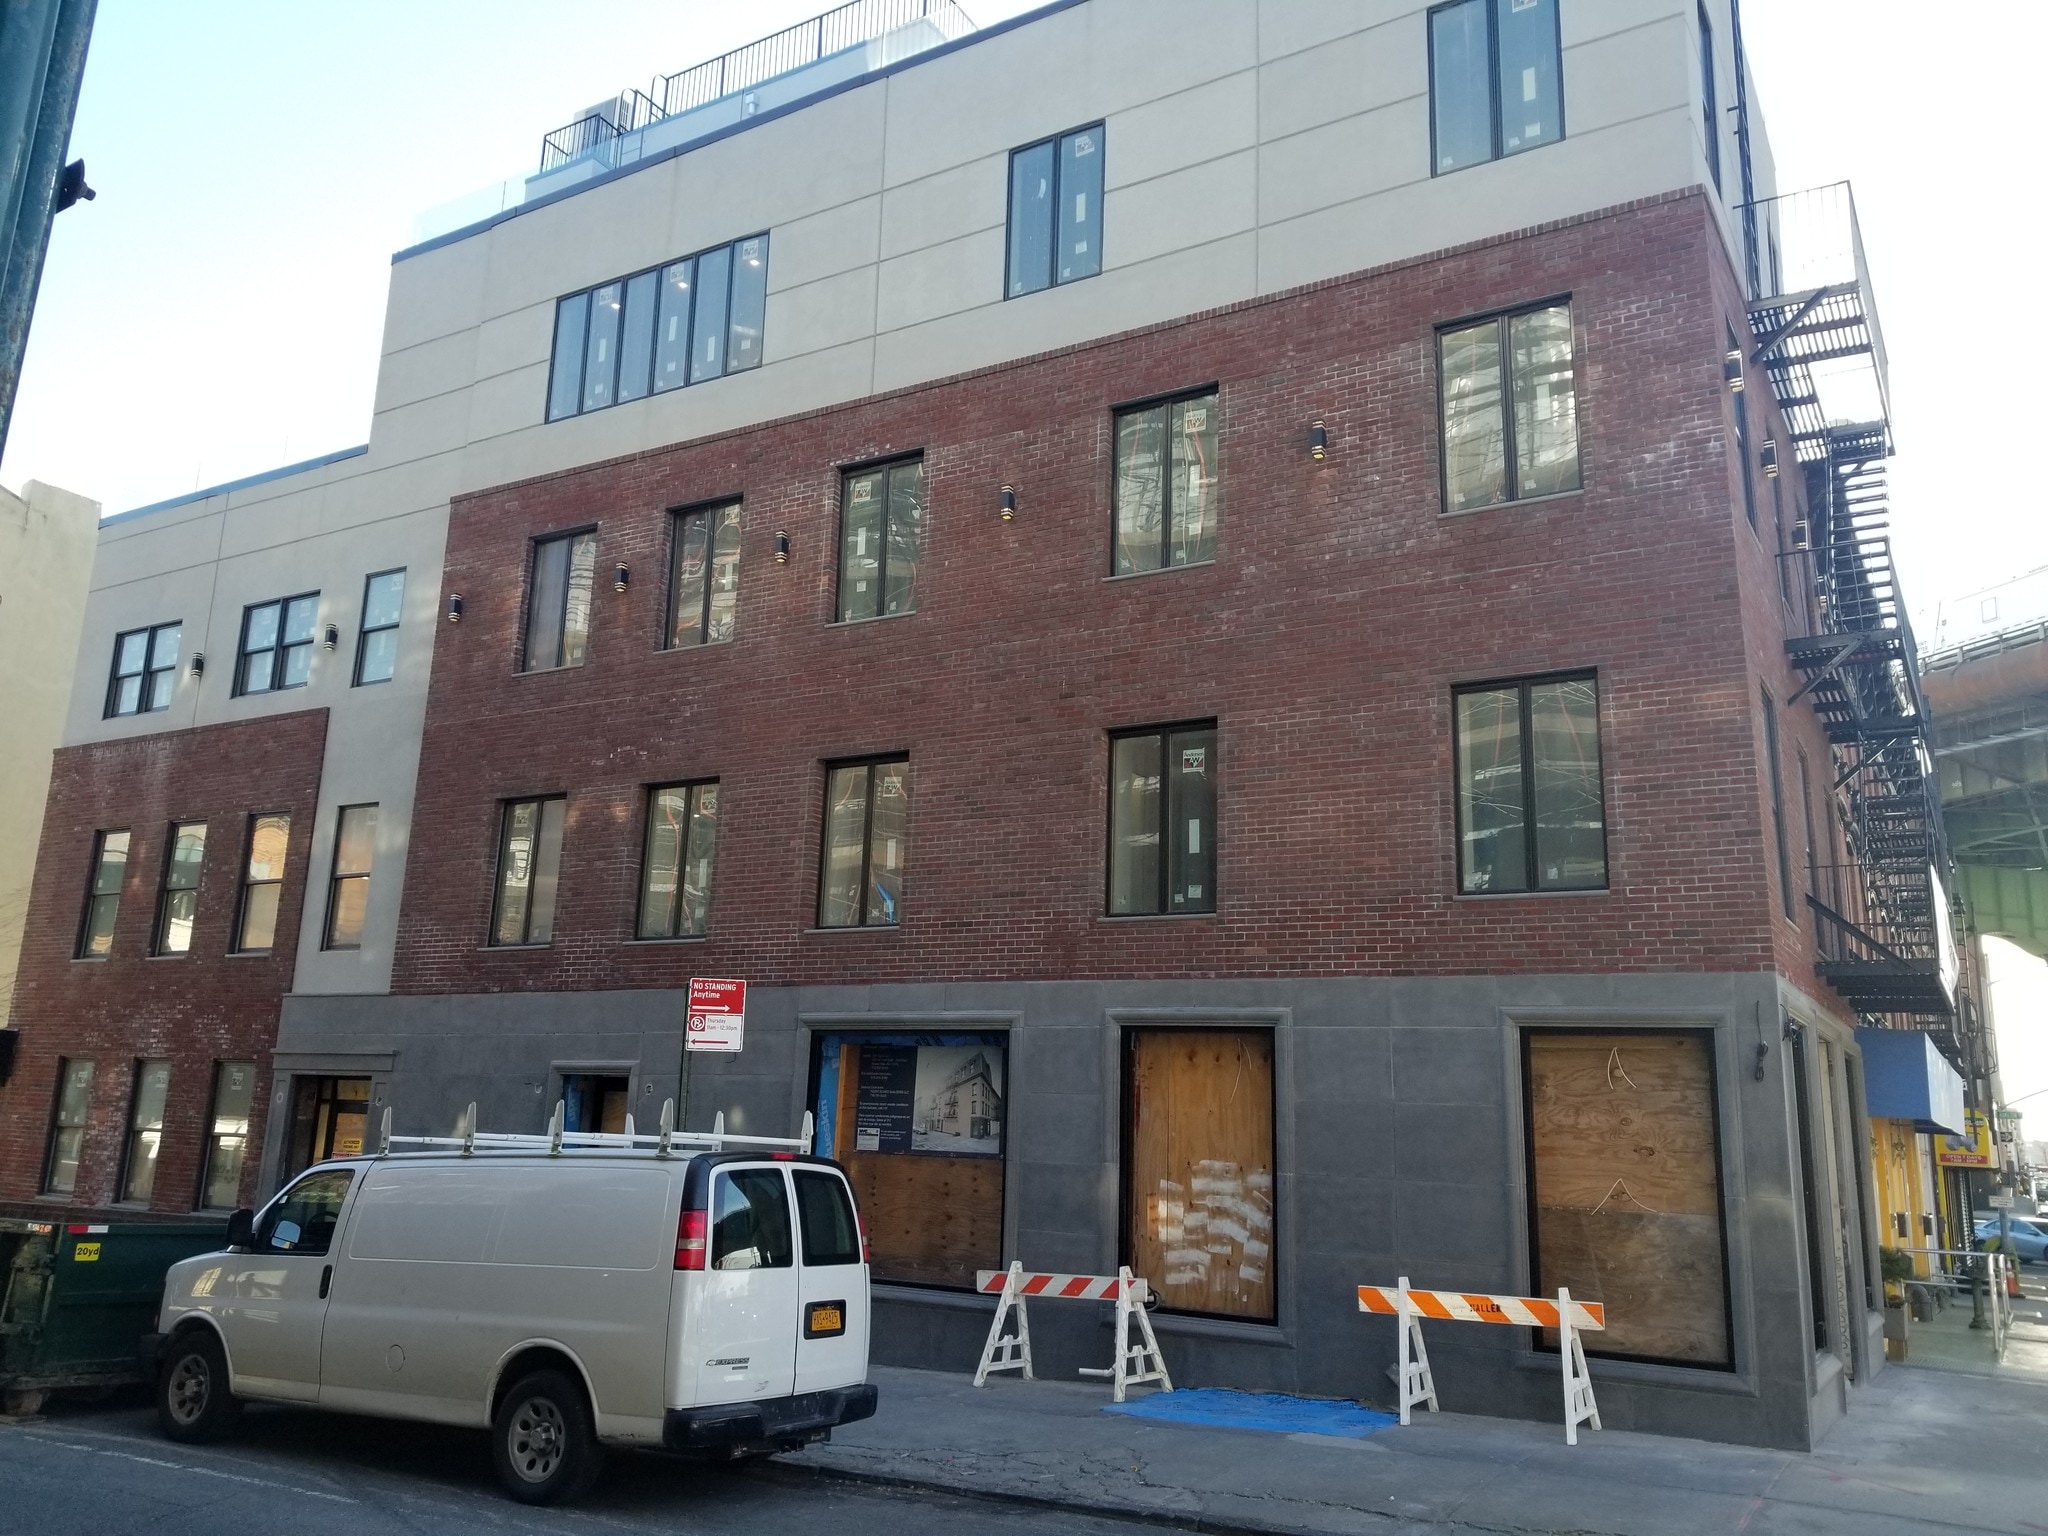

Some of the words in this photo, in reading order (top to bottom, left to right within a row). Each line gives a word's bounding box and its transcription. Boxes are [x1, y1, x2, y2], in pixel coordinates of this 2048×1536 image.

[693, 982, 703, 990] NO
[704, 983, 737, 991] STANDING
[693, 991, 720, 999] Anytime
[821, 1099, 834, 1160] lueskin
[77, 1247, 100, 1257] 20yd
